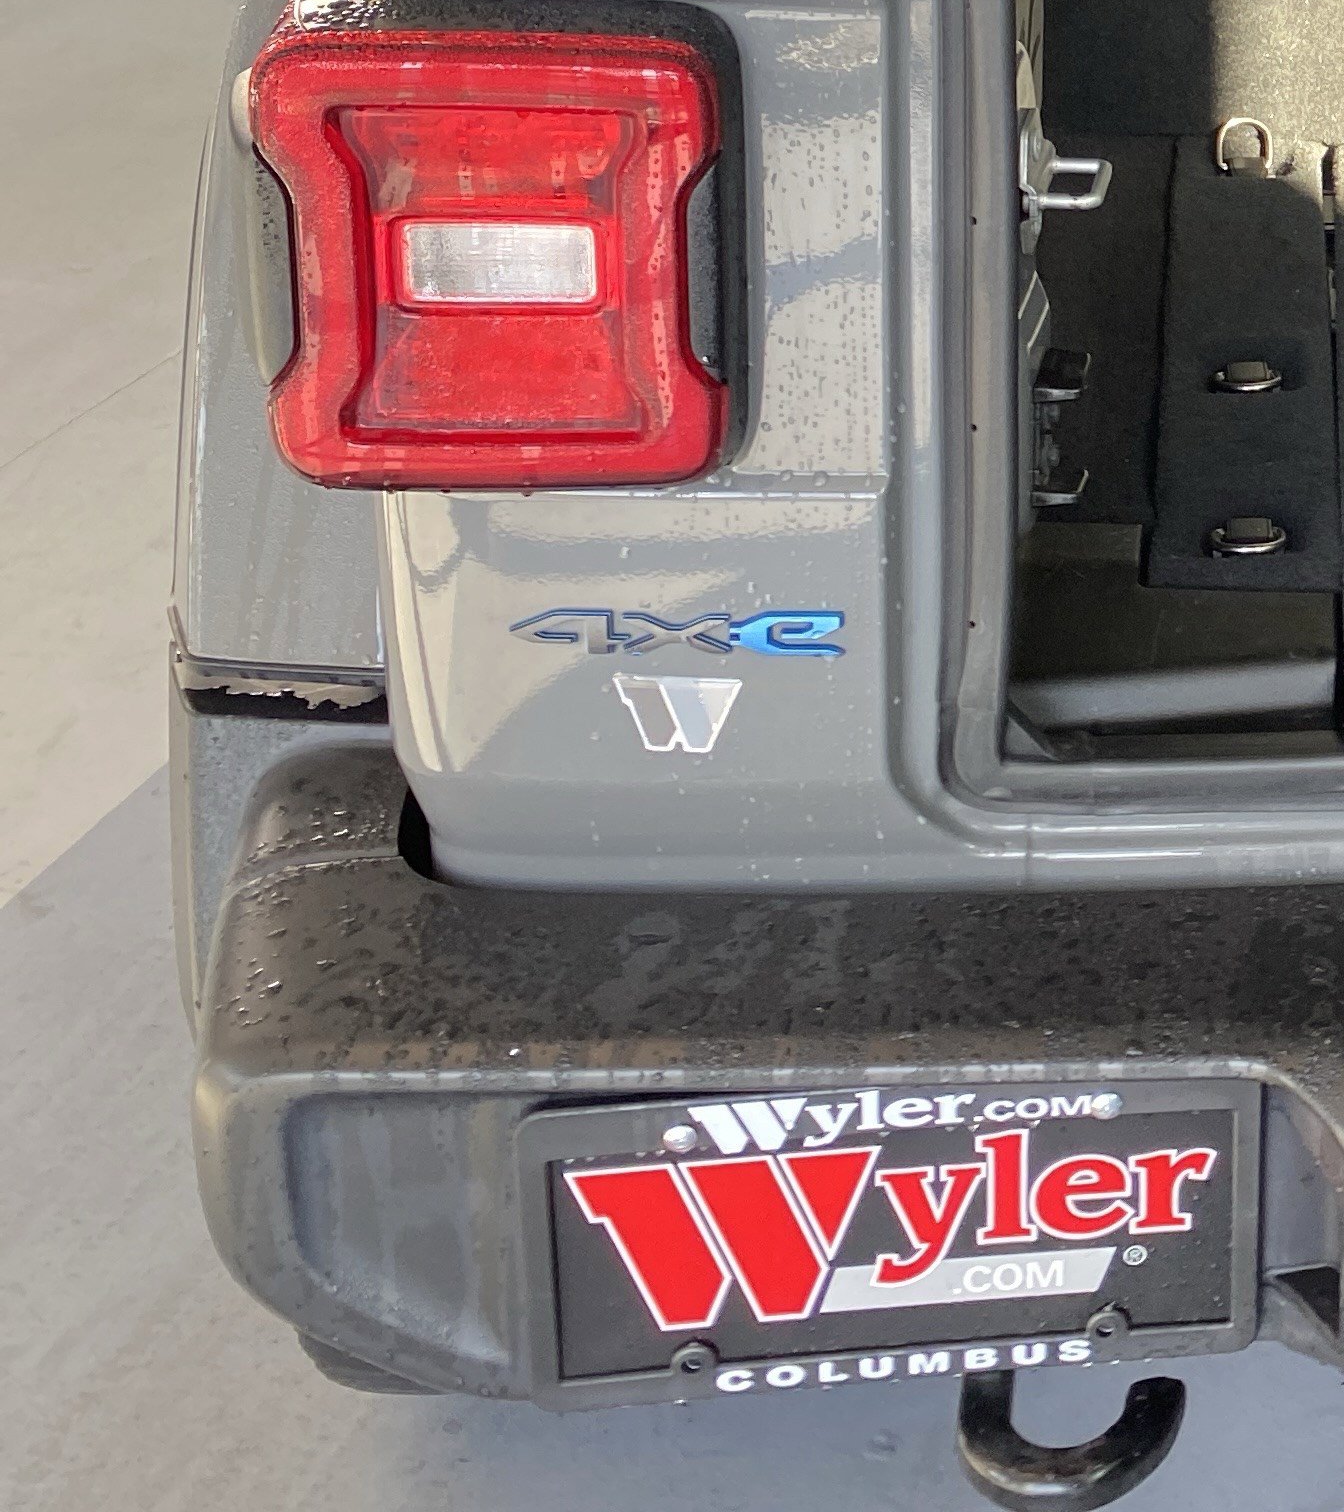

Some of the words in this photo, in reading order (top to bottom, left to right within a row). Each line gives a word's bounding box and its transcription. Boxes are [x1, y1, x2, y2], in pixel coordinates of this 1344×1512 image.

[563, 1128, 1217, 1331] Wyler
[953, 1259, 1065, 1295] .COM
[715, 1339, 1092, 1392] COLUMBUS
